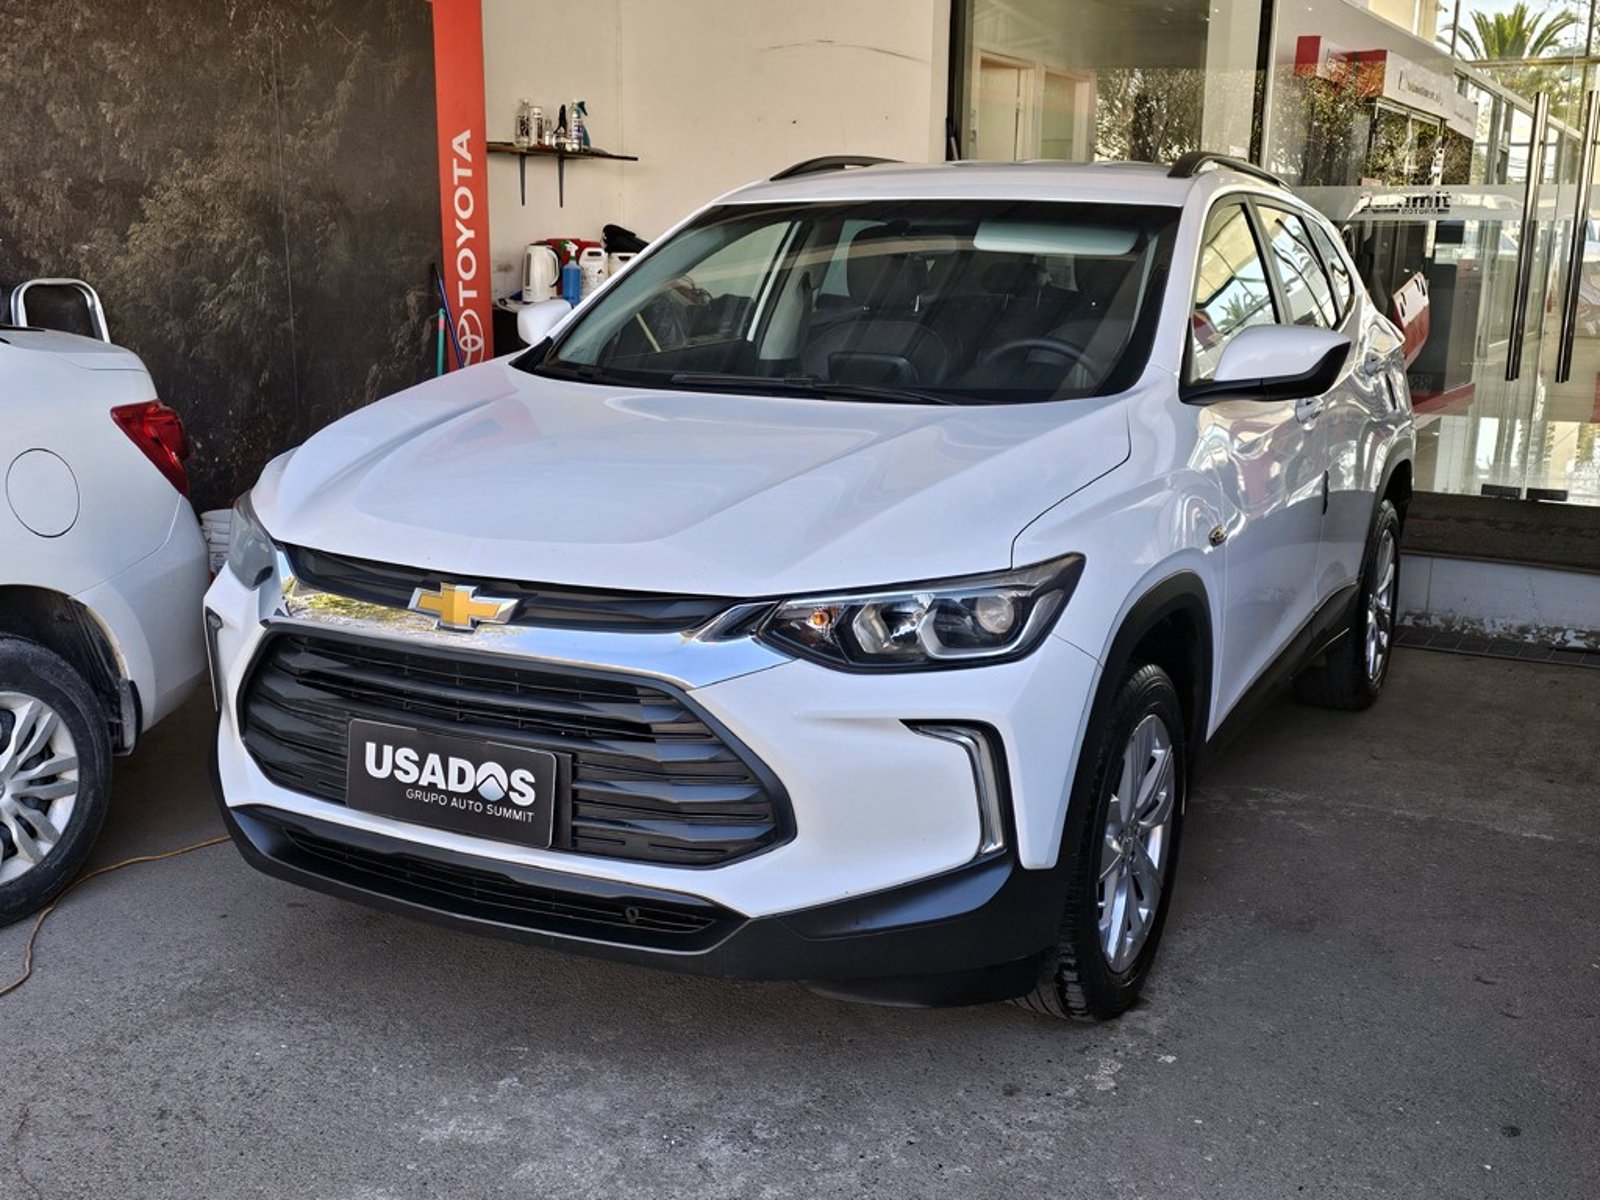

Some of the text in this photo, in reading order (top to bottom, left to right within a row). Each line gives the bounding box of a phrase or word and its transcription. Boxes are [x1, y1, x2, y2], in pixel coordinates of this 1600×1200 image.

[451, 128, 478, 308] TOYOTA
[365, 741, 536, 807] USADOS
[405, 788, 535, 823] GRUPO AUTO SUMMIT
